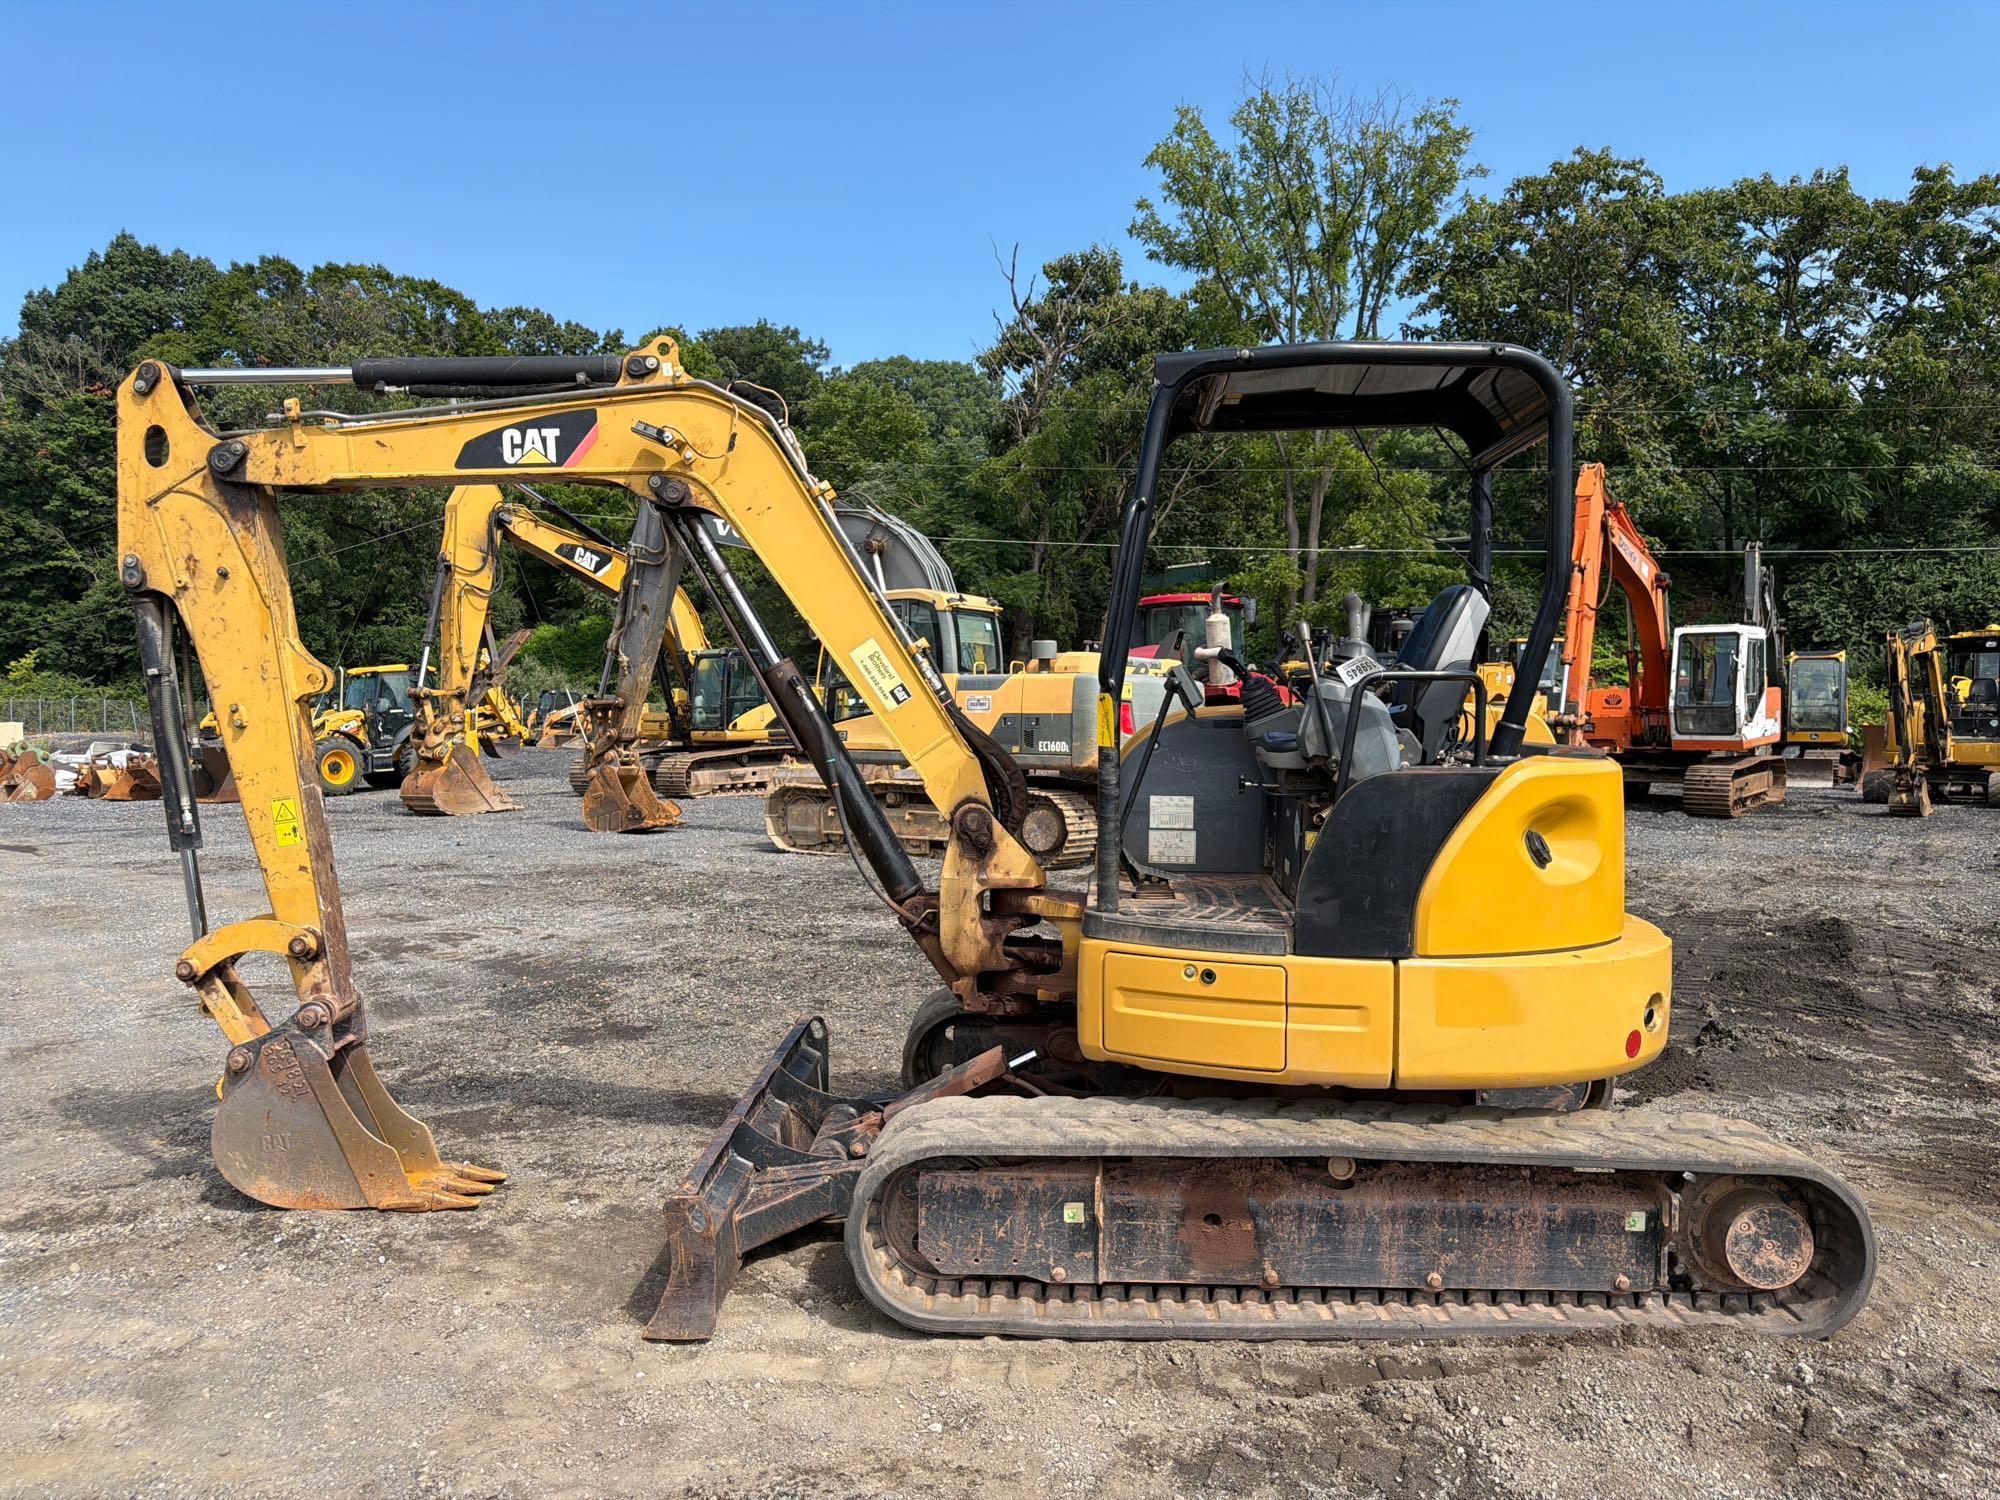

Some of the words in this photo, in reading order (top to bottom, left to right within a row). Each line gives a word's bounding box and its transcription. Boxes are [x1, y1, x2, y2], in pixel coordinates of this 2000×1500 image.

[502, 428, 560, 464] CAT
[574, 546, 601, 572] CAT
[868, 653, 887, 680] Brothers
[873, 650, 895, 680] Cleveland
[893, 685, 908, 702] CAT
